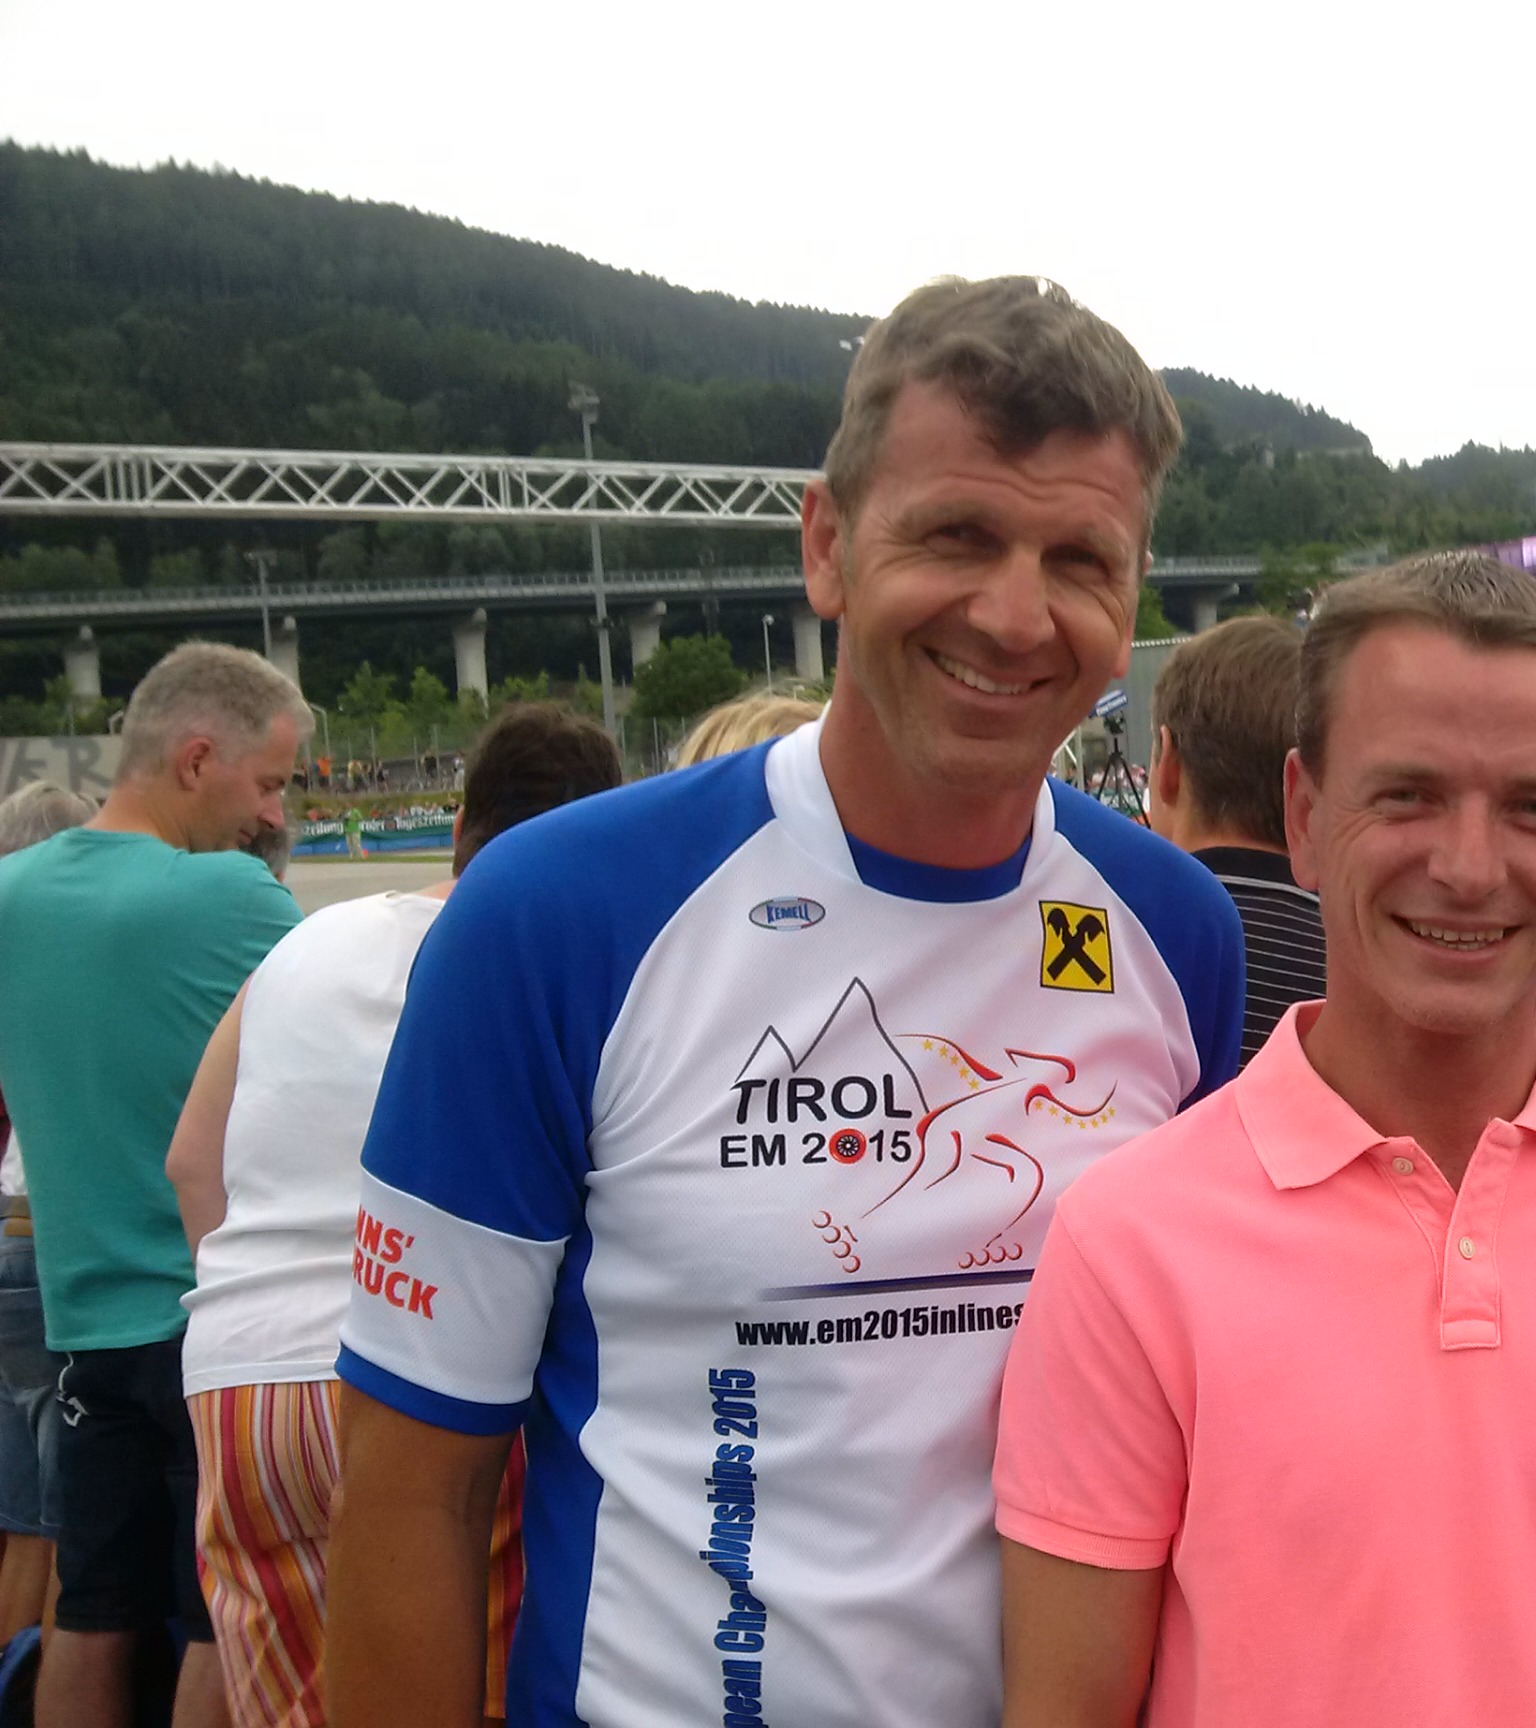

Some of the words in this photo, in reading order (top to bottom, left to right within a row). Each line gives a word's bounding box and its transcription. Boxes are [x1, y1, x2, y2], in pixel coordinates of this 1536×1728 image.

[731, 1073, 913, 1124] TIROL
[720, 1133, 786, 1168] EM
[802, 1128, 912, 1166] 2015
[353, 1245, 438, 1320] RUCK
[709, 1368, 758, 1439] 2015
[721, 1659, 768, 1728] pean
